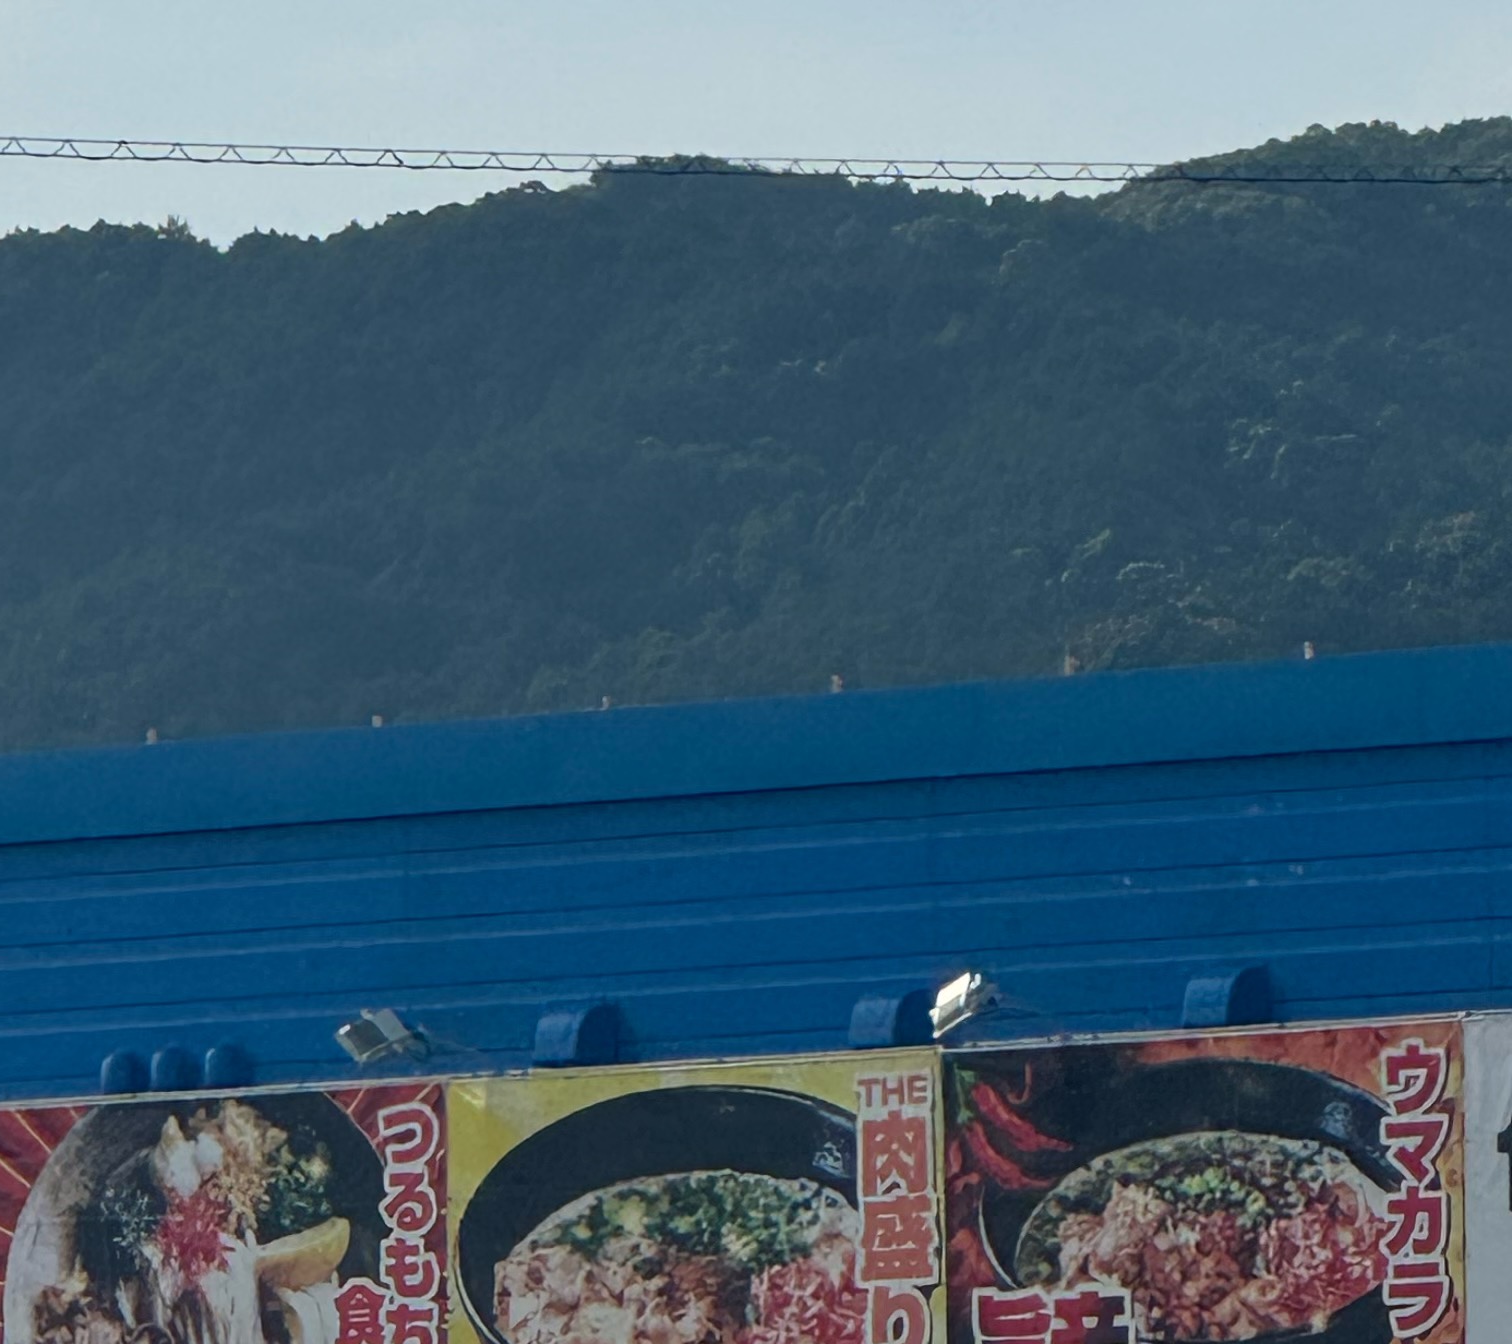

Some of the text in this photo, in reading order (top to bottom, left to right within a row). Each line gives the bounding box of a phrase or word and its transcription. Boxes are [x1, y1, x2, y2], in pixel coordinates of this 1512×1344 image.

[856, 1075, 930, 1107] THE
[1381, 1040, 1449, 1338] ウマカラ
